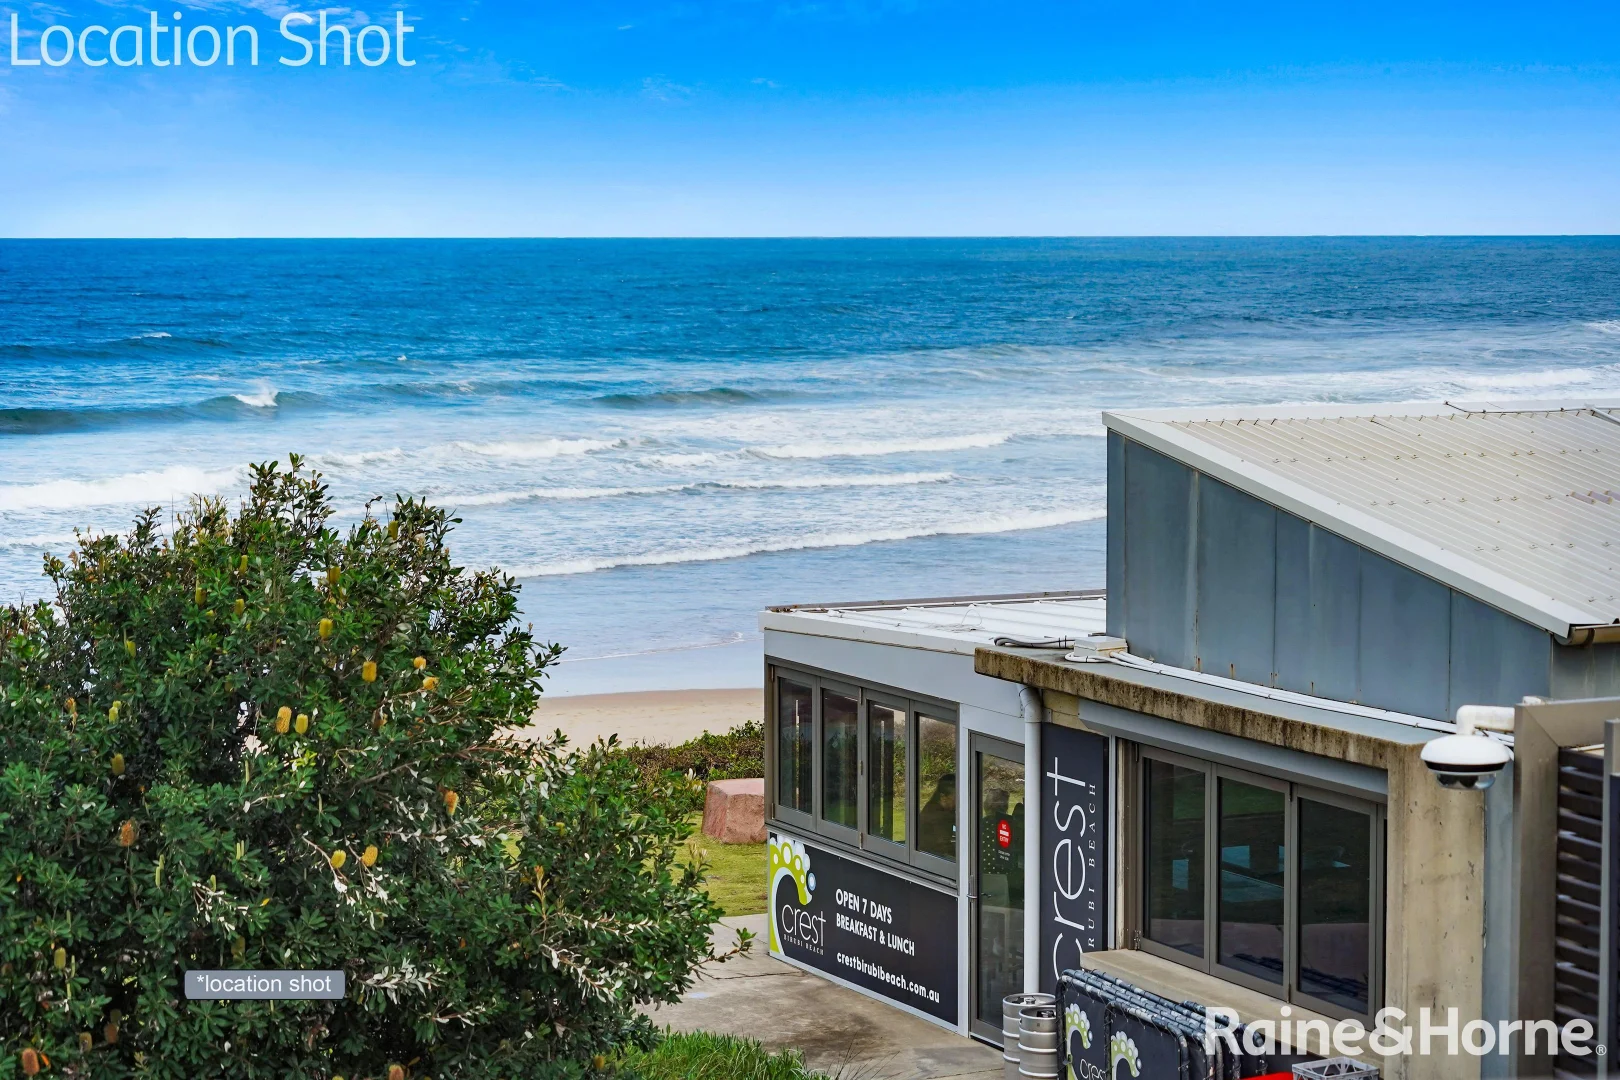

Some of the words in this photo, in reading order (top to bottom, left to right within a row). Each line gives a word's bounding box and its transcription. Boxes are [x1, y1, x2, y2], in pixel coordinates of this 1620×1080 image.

[1088, 783, 1096, 868] BEACH
[781, 904, 827, 947] crest
[835, 888, 860, 912] OPEN
[862, 898, 868, 915] 7
[870, 900, 893, 925] DAYS
[1087, 887, 1096, 948] RUBI
[836, 912, 878, 943] BREAKFAST
[879, 930, 886, 946] &
[887, 933, 915, 957] LUNCH
[836, 951, 940, 1004] crestbirubibeach.com.au
